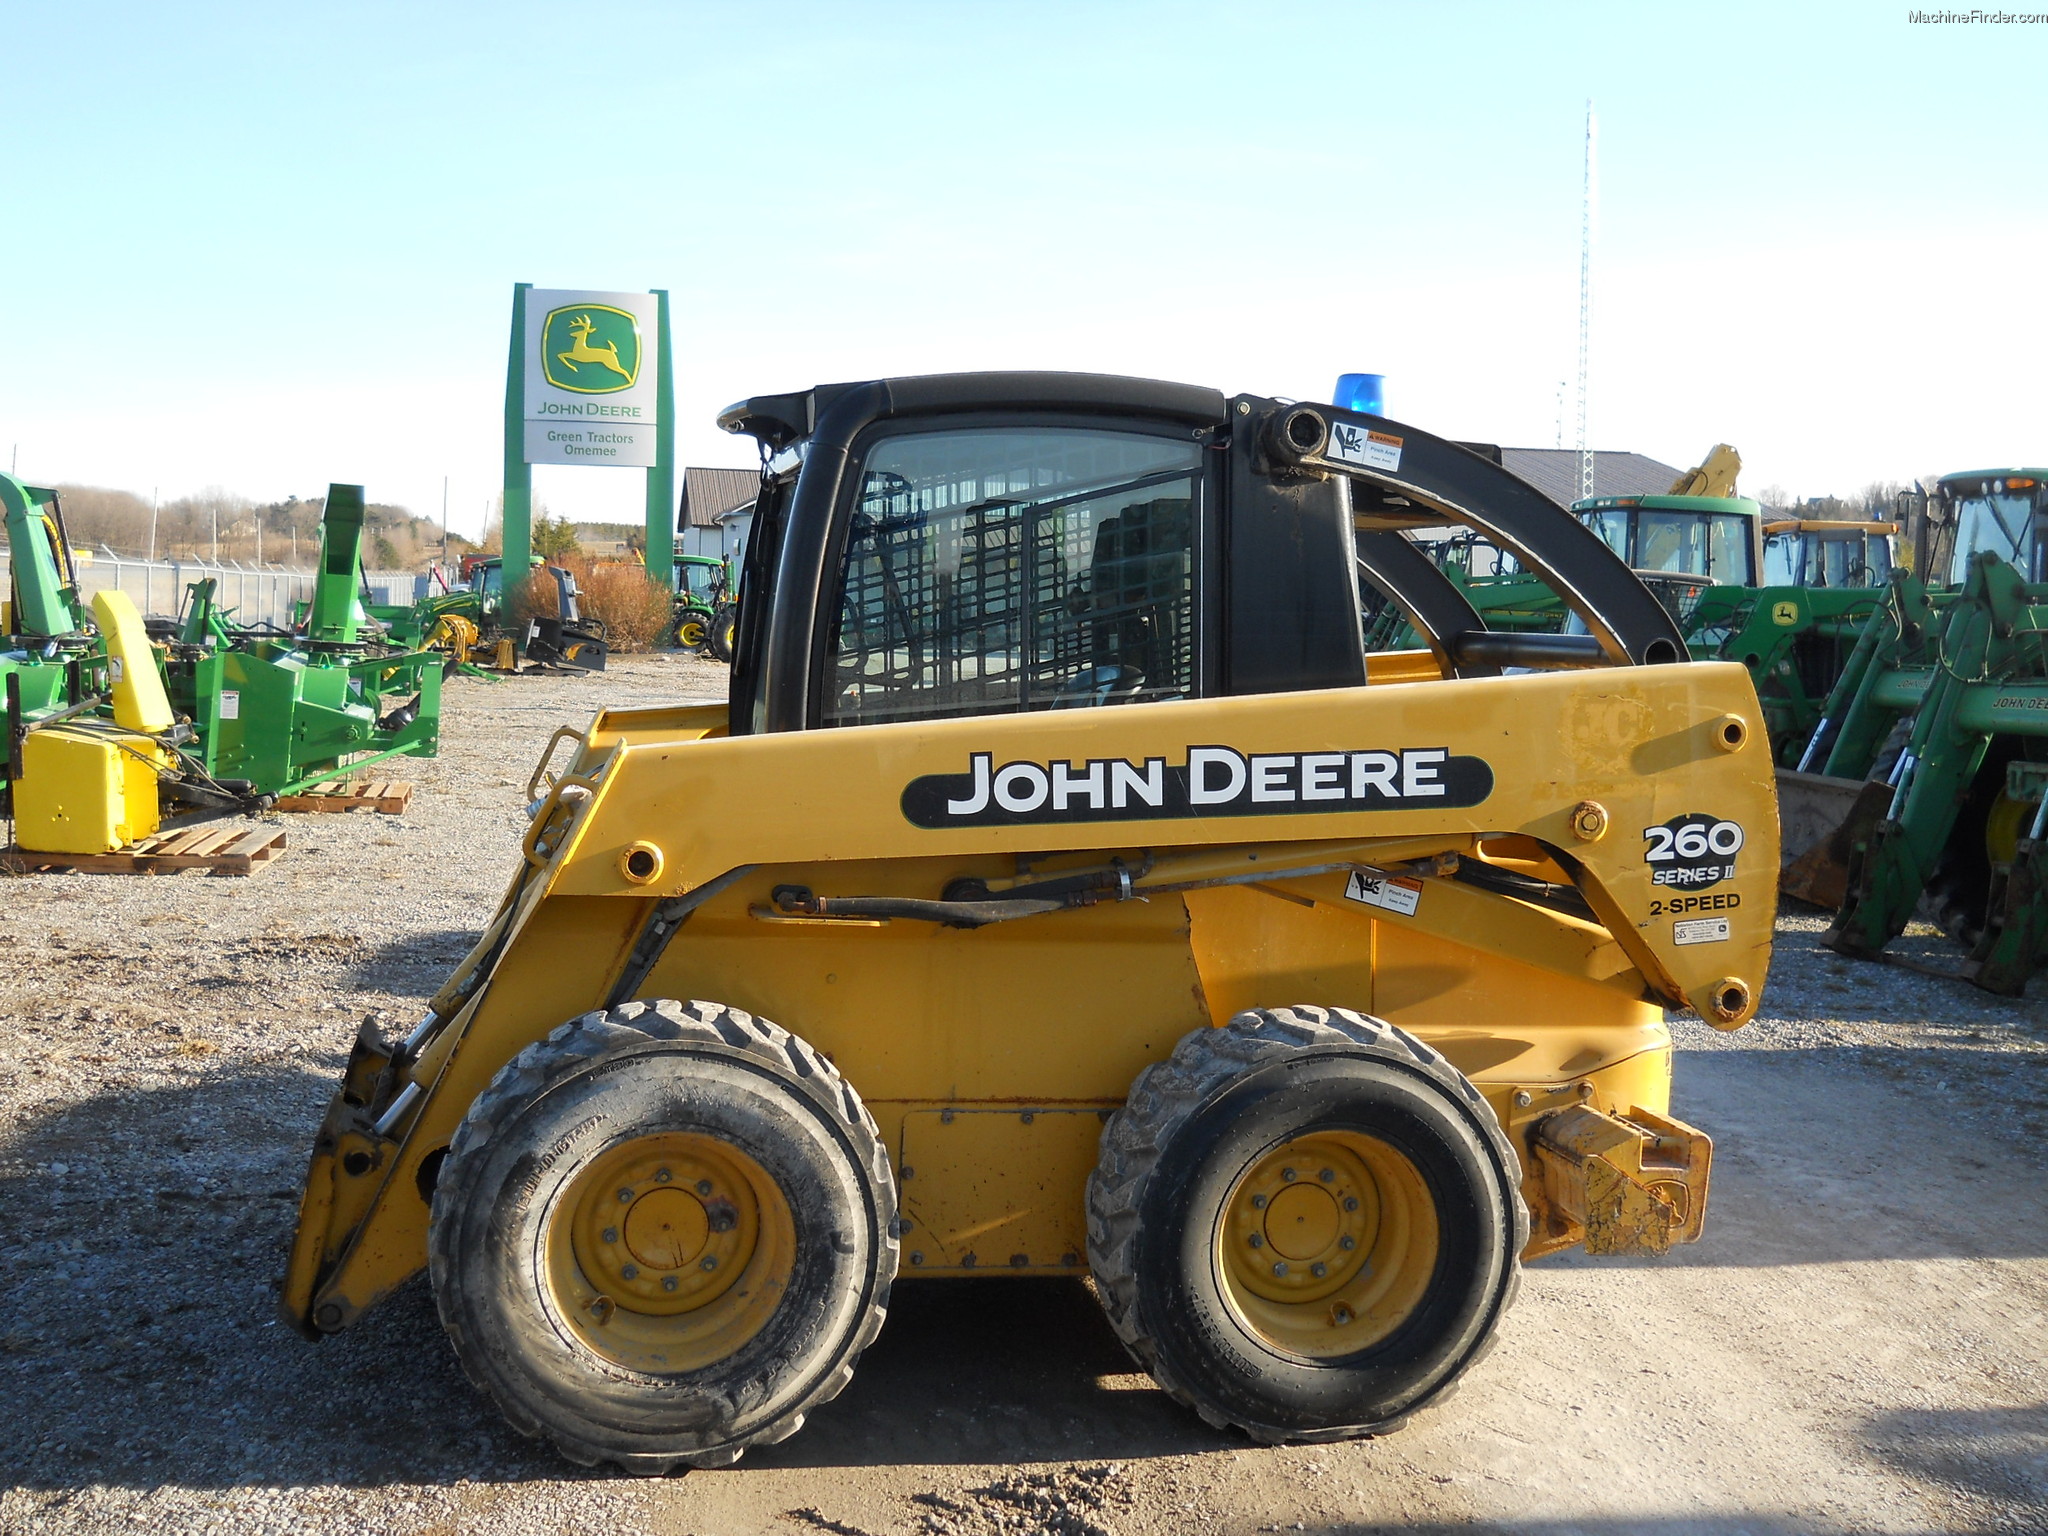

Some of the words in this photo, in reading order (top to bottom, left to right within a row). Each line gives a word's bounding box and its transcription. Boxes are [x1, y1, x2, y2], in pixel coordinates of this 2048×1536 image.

[538, 402, 583, 415] JOHN
[586, 403, 641, 417] DEERE
[548, 430, 582, 442] Green
[587, 432, 634, 444] Tractors
[564, 444, 617, 456] Omemee
[1993, 698, 2024, 708] JOHN
[947, 754, 1163, 815] JOHN
[1190, 748, 1445, 805] DEERE
[1644, 821, 1743, 861] 260
[1652, 866, 1720, 885] SERIES
[1650, 893, 1741, 916] 2-SPEED
